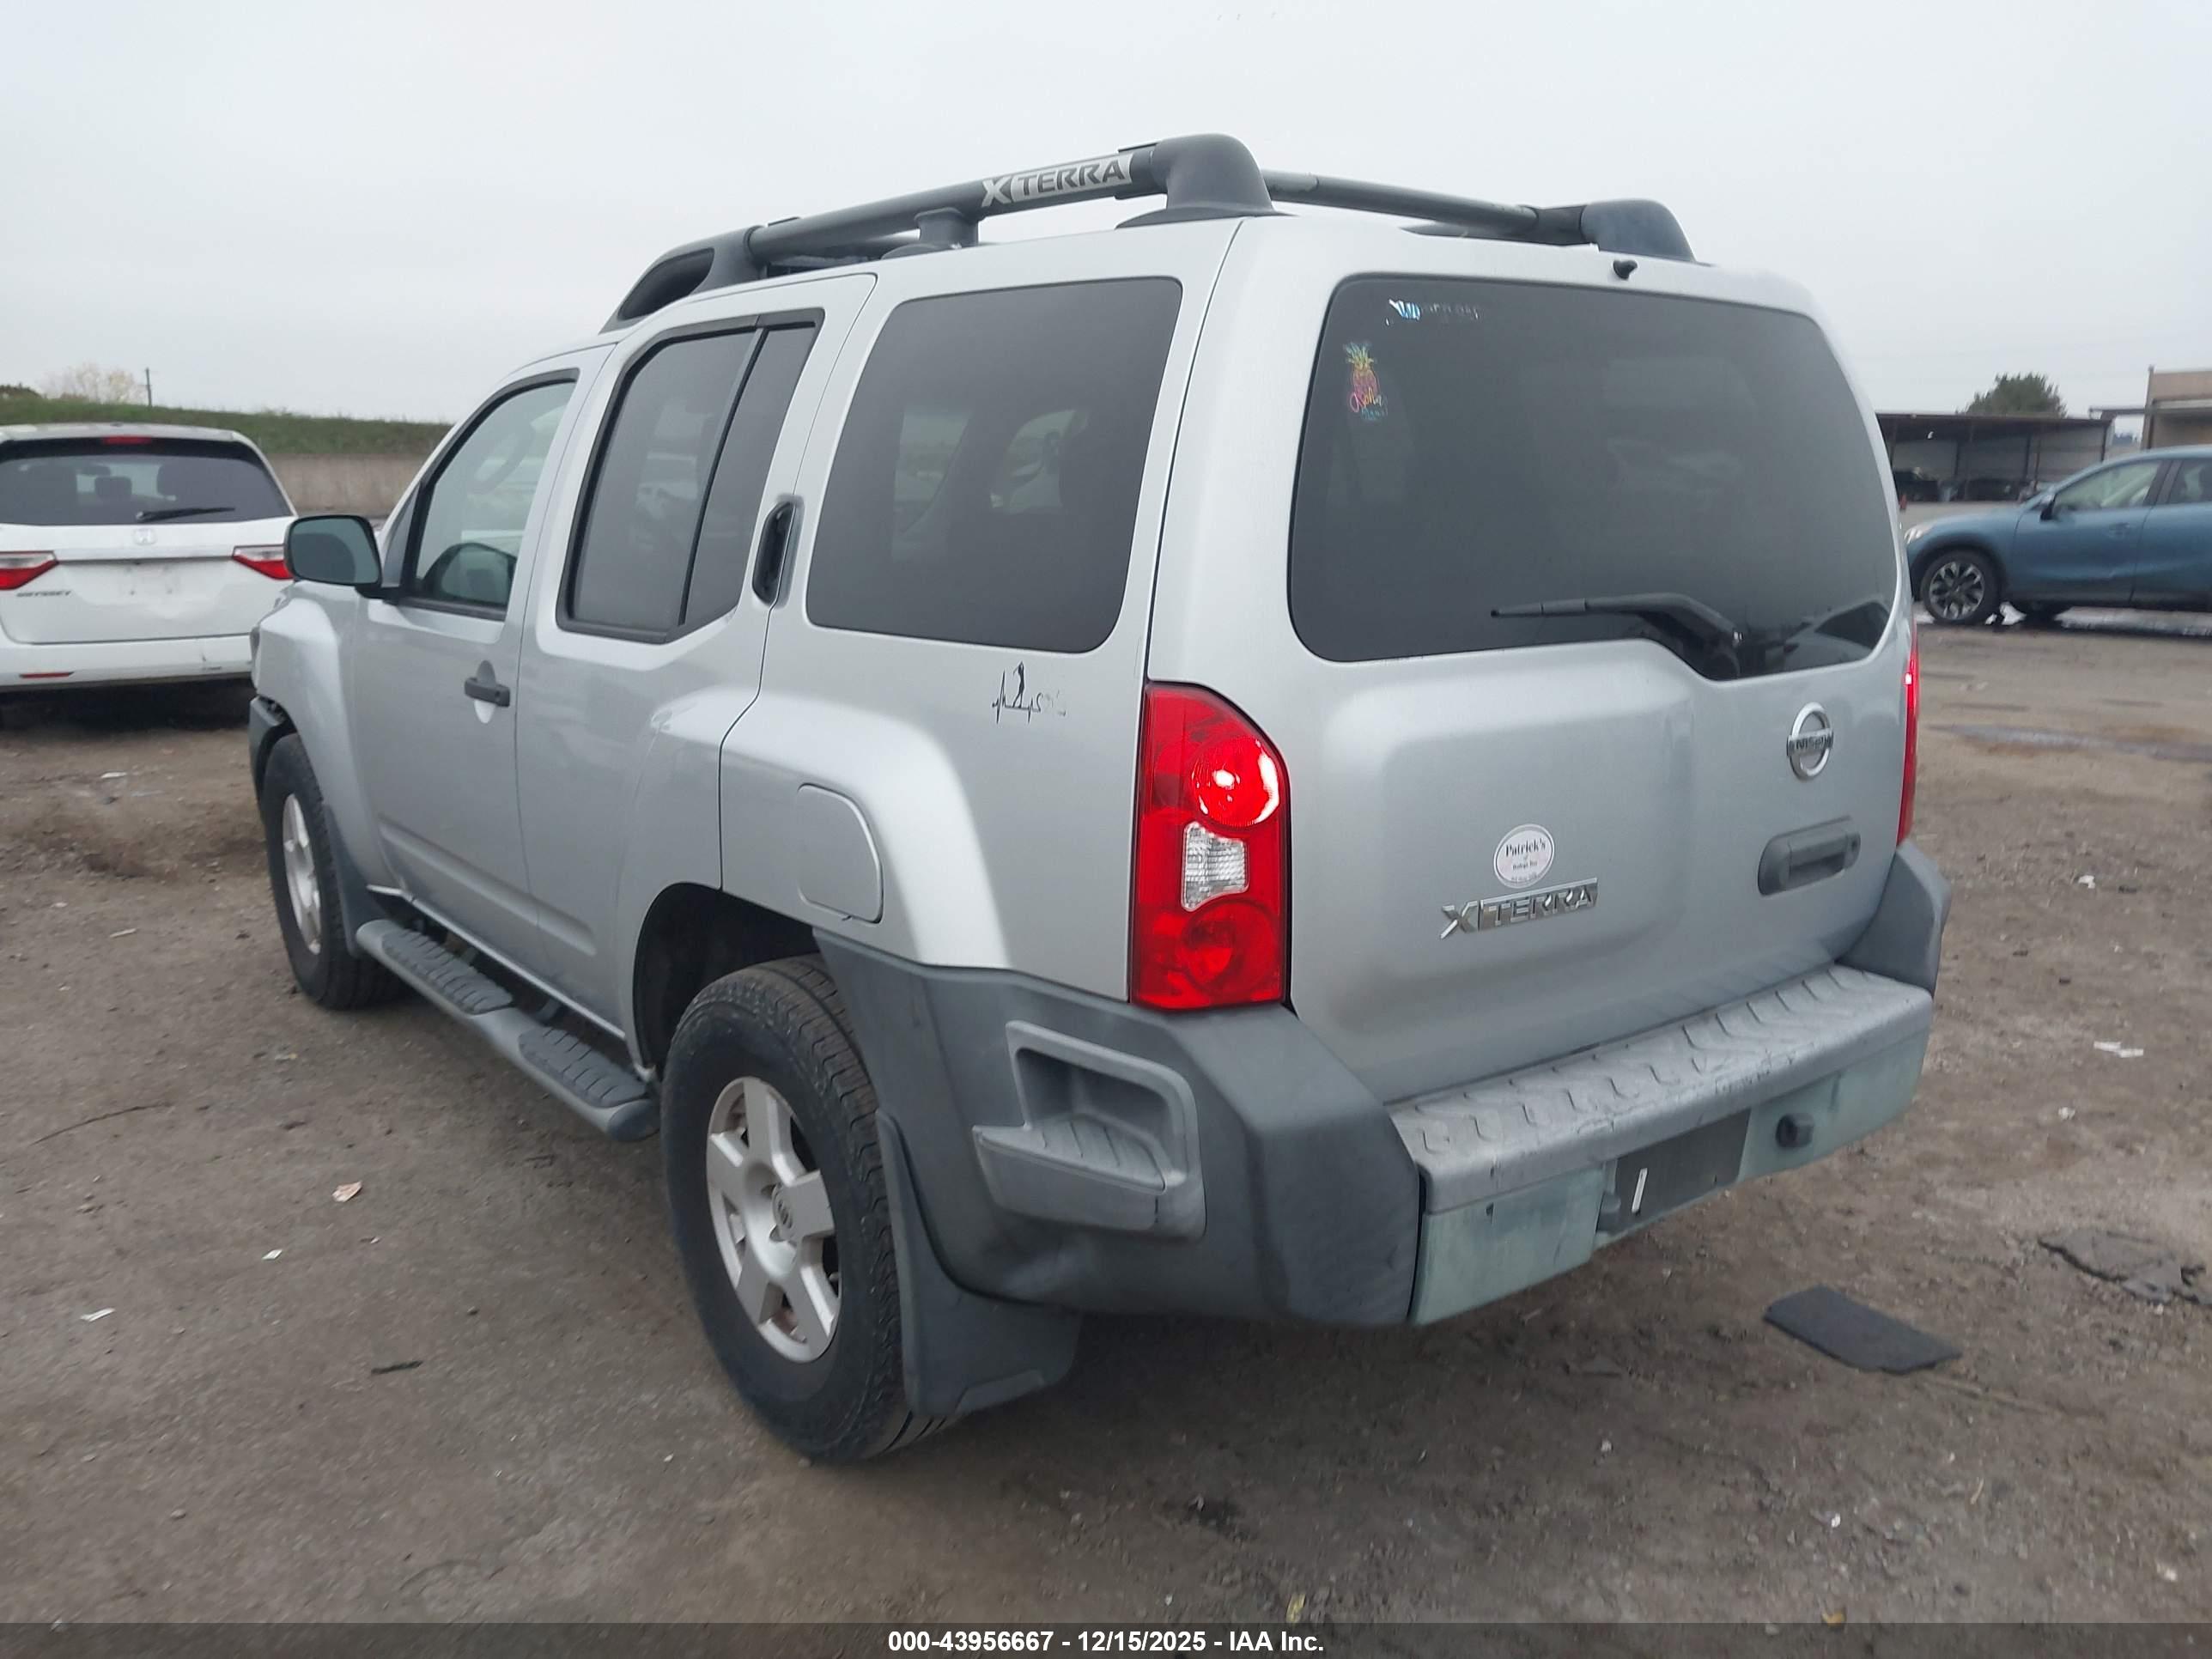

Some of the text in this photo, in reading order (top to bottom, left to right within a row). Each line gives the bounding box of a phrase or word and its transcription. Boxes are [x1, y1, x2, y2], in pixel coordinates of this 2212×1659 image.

[981, 160, 1126, 207] XTERRA
[1505, 837, 1546, 857] Patrick's
[1440, 883, 1595, 939] XTERRA
